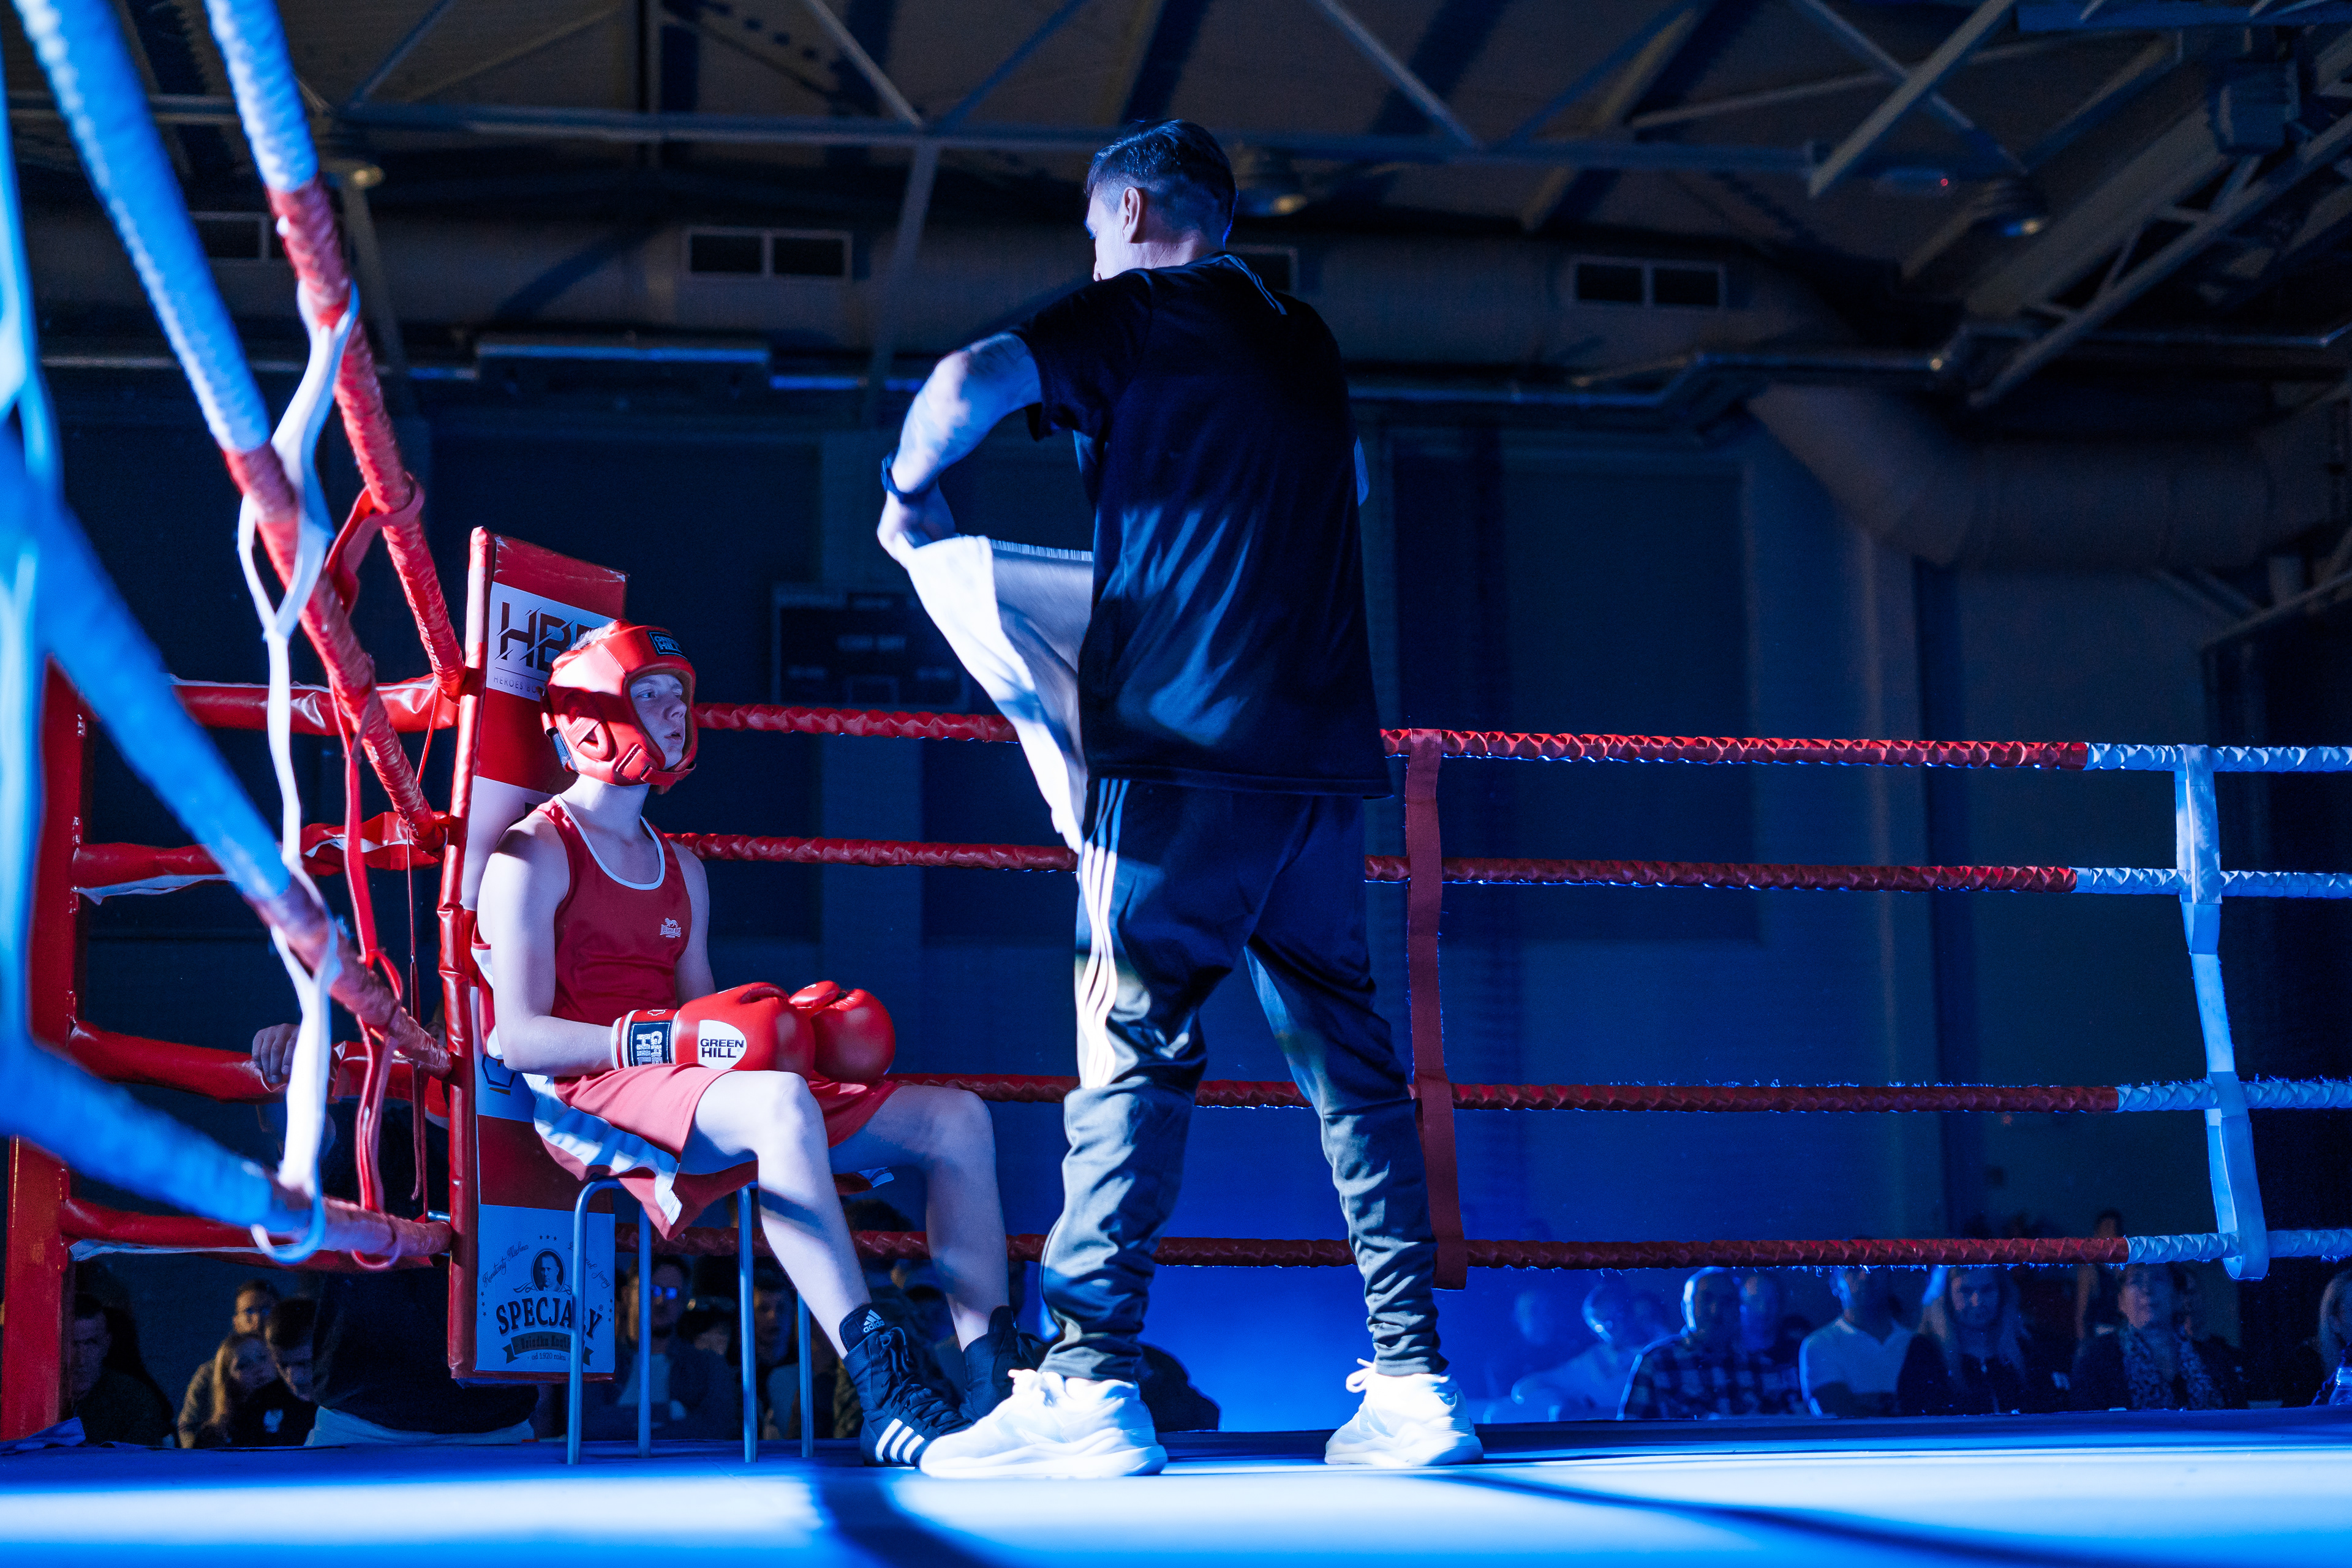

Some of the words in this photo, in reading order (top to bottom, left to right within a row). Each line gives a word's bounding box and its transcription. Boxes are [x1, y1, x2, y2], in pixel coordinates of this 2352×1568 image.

[495, 601, 599, 673] HB
[494, 676, 523, 690] HEROES
[636, 1033, 651, 1066] HIL
[650, 1031, 663, 1065] GRE
[700, 1038, 745, 1048] GREEN
[701, 1047, 737, 1058] HILL
[496, 1297, 603, 1339] SPECJAY
